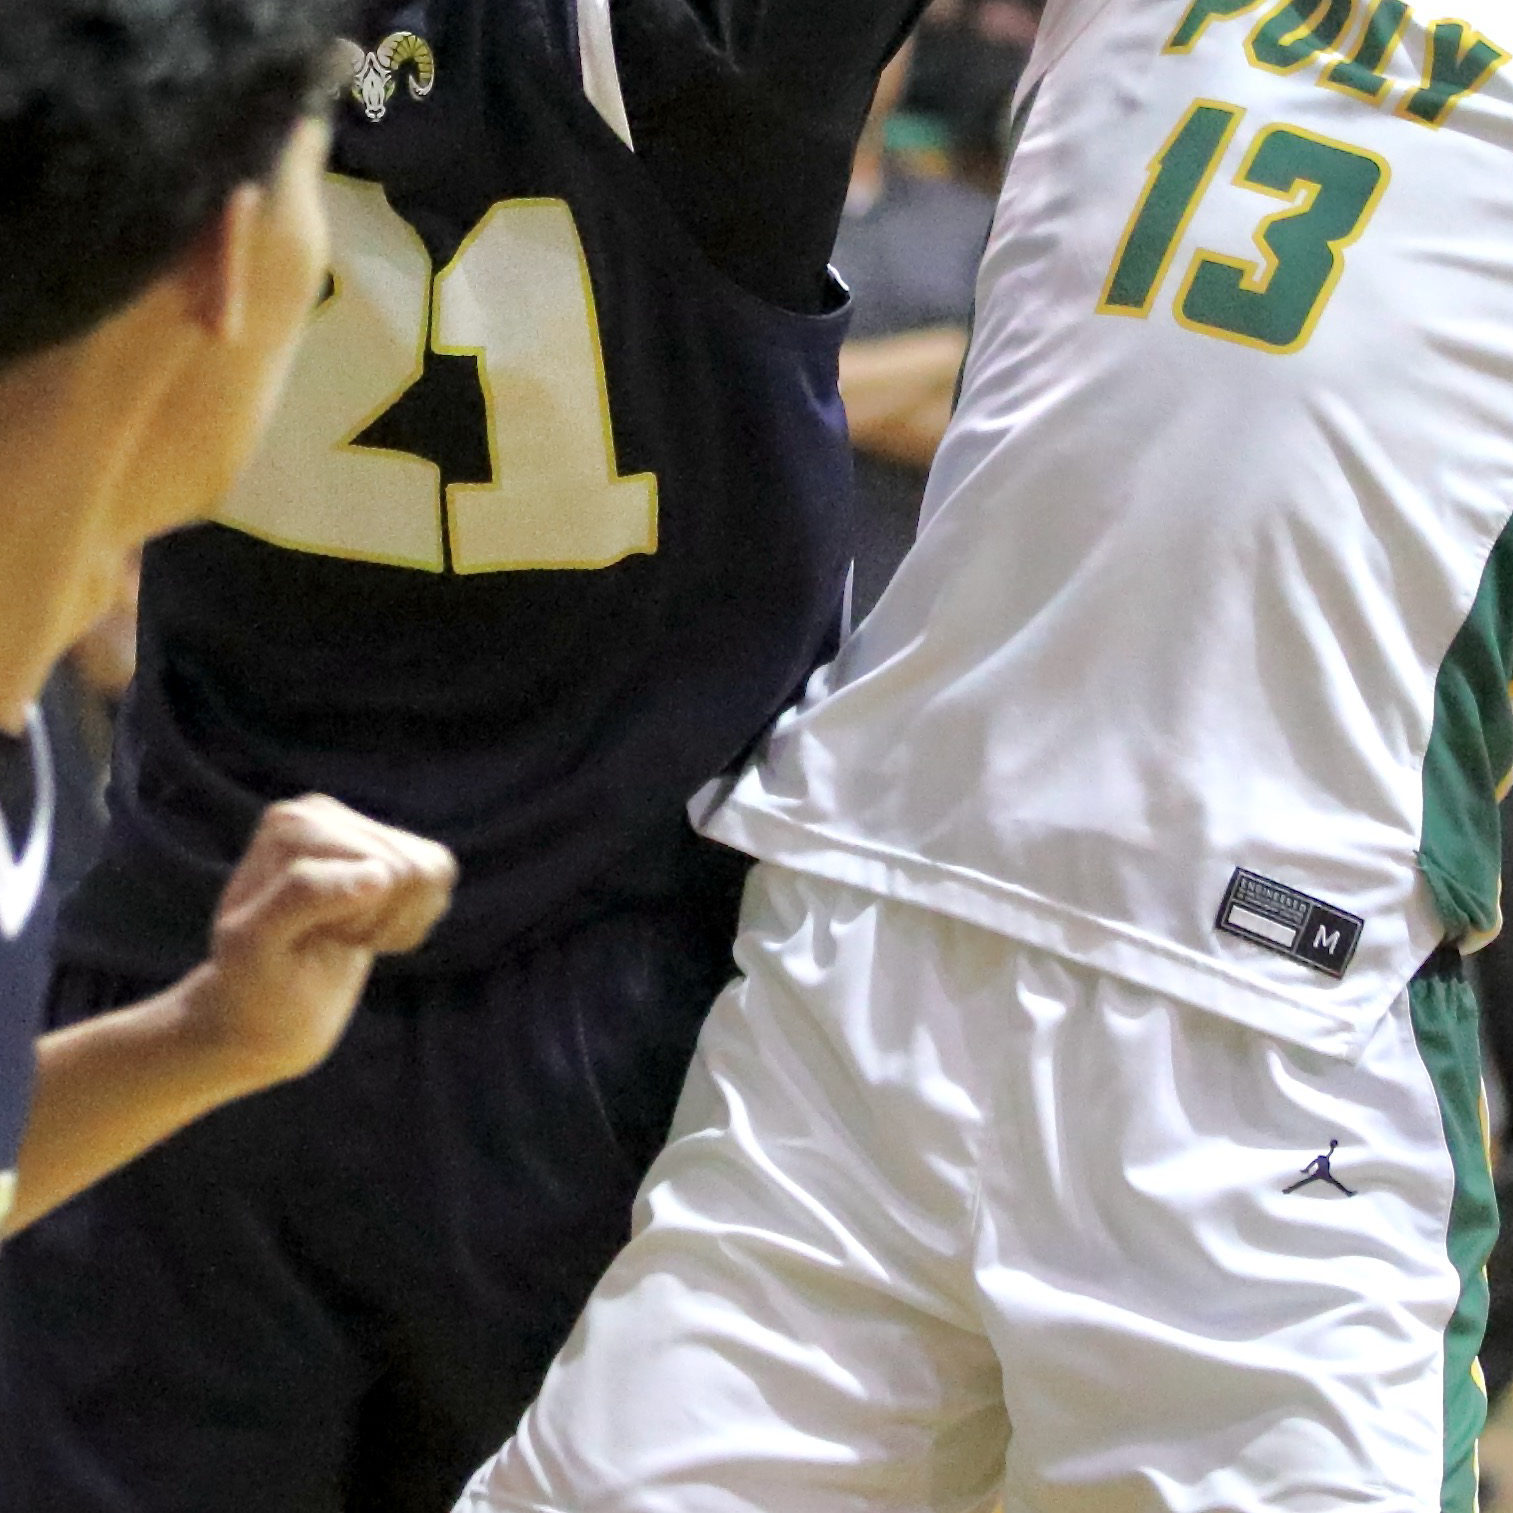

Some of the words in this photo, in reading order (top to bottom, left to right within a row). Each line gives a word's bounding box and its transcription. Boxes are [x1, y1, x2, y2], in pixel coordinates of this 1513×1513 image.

[1095, 98, 1392, 355] 13
[204, 171, 657, 575] 21
[1312, 924, 1341, 955] M
